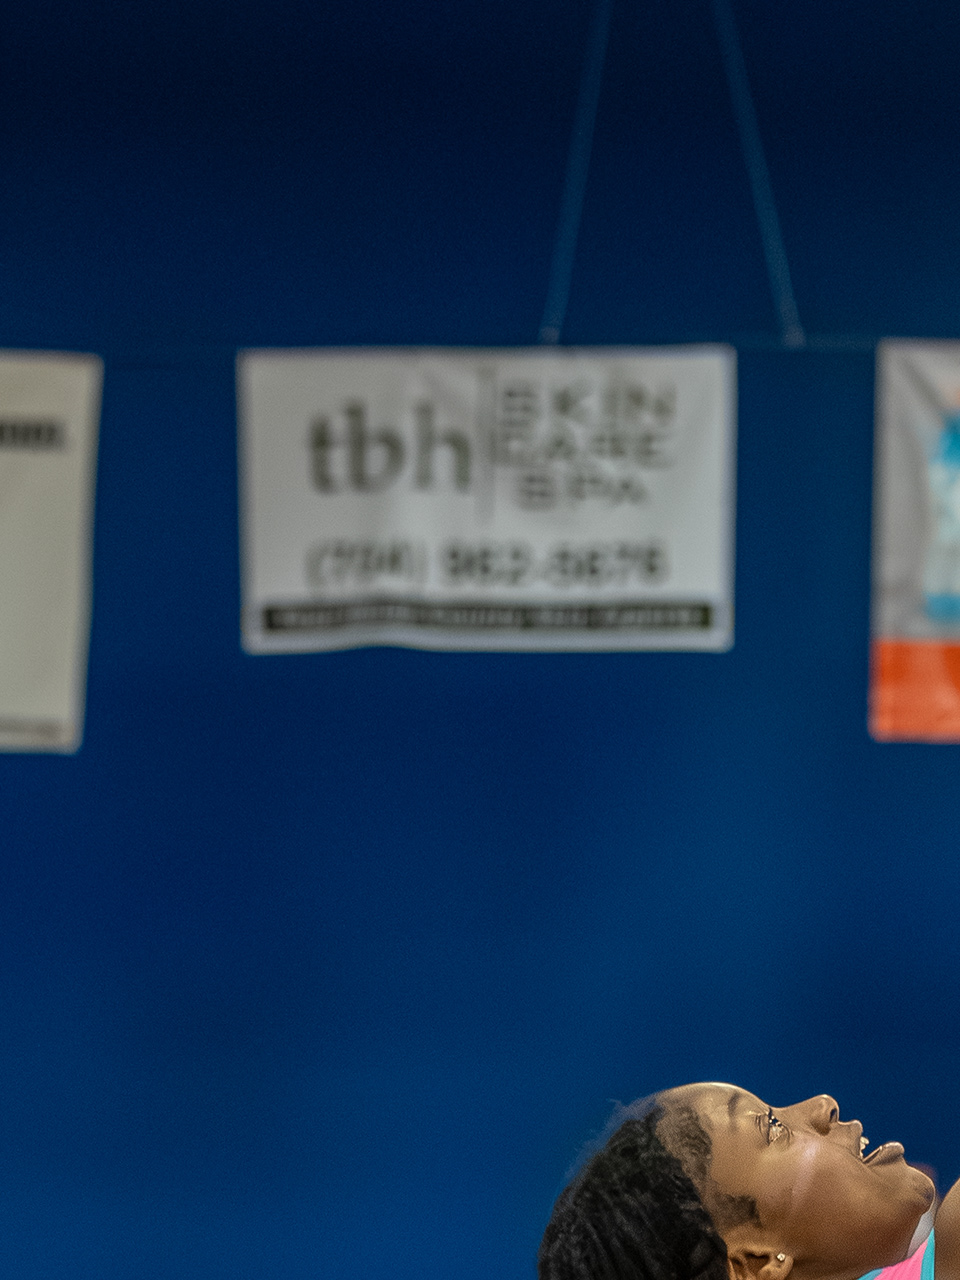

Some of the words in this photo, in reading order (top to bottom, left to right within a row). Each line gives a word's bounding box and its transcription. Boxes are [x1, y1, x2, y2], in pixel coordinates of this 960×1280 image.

[499, 381, 675, 425] SKIN
[309, 398, 474, 496] tbh
[492, 428, 673, 467] CARE
[516, 468, 650, 508] SPA
